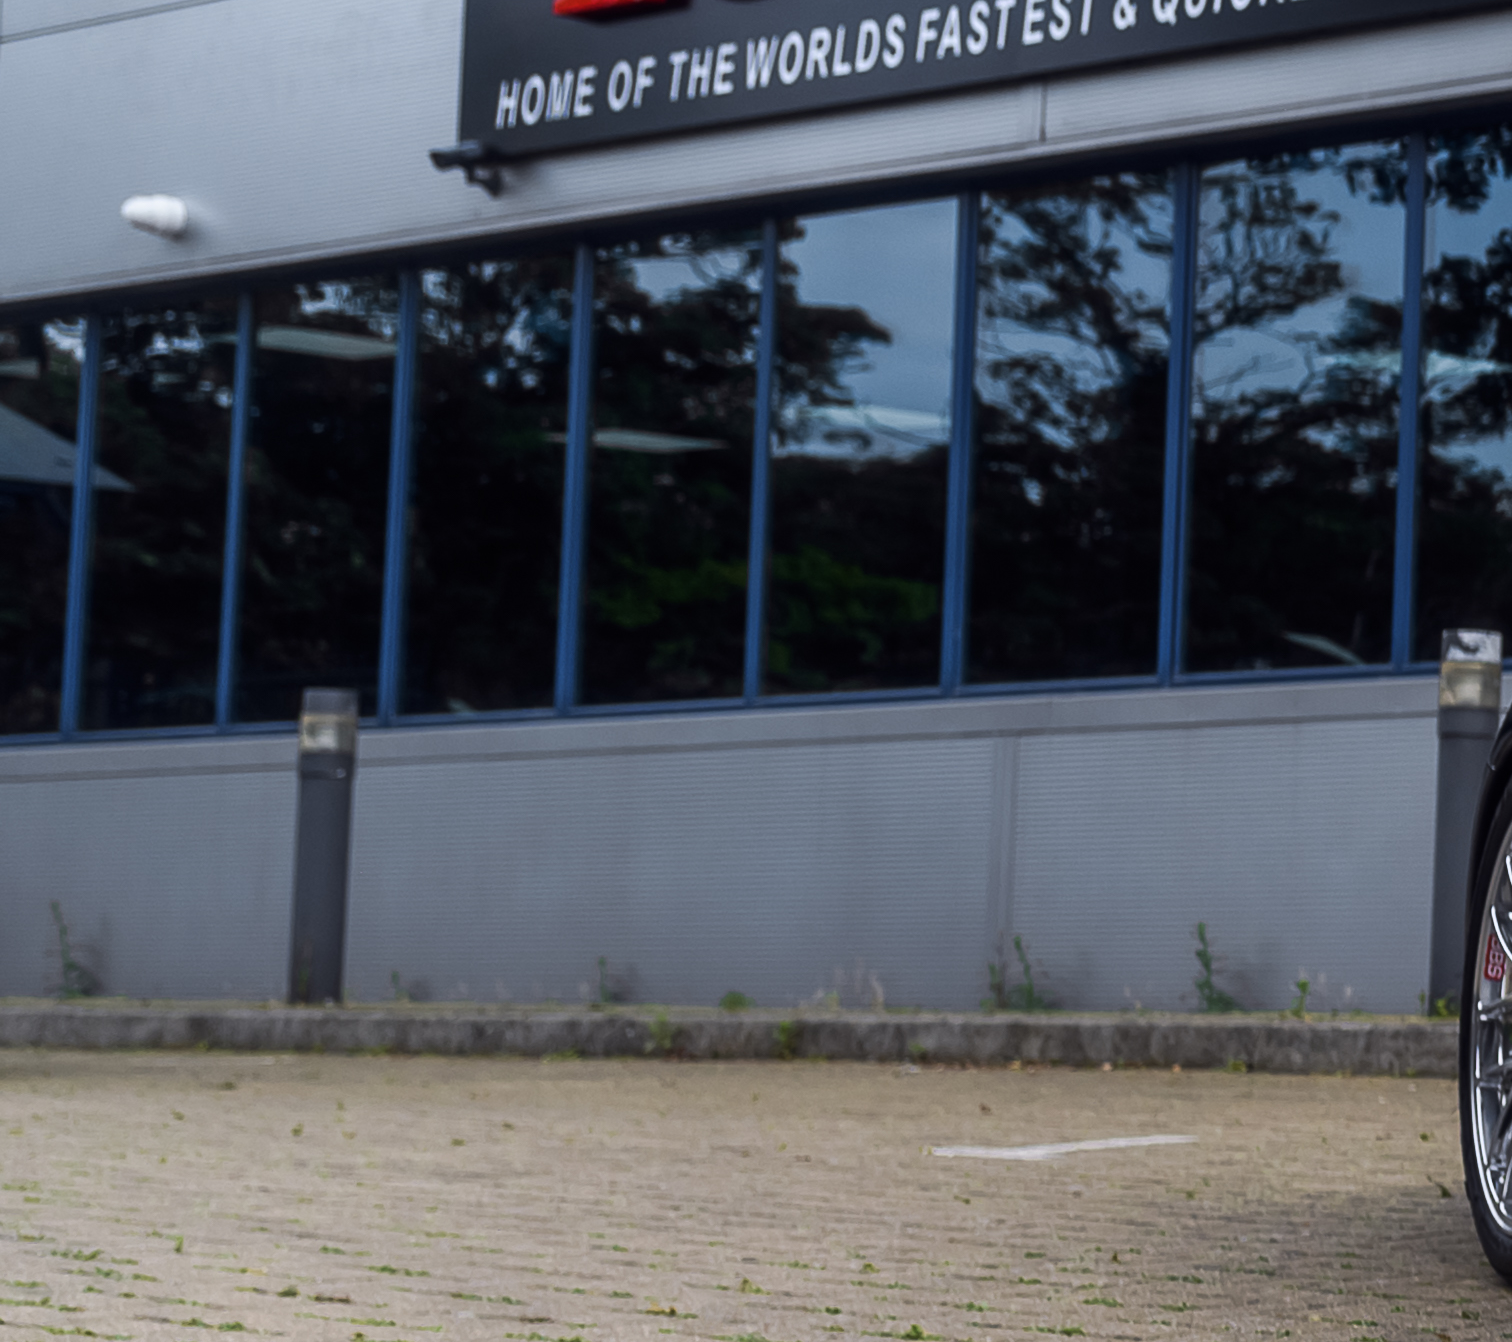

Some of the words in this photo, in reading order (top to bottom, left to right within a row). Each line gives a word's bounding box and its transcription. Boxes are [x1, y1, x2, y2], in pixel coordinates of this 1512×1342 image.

[496, 67, 597, 127] HOME
[608, 57, 656, 111] OF
[670, 43, 737, 98] THE
[747, 15, 905, 88] WORLDS
